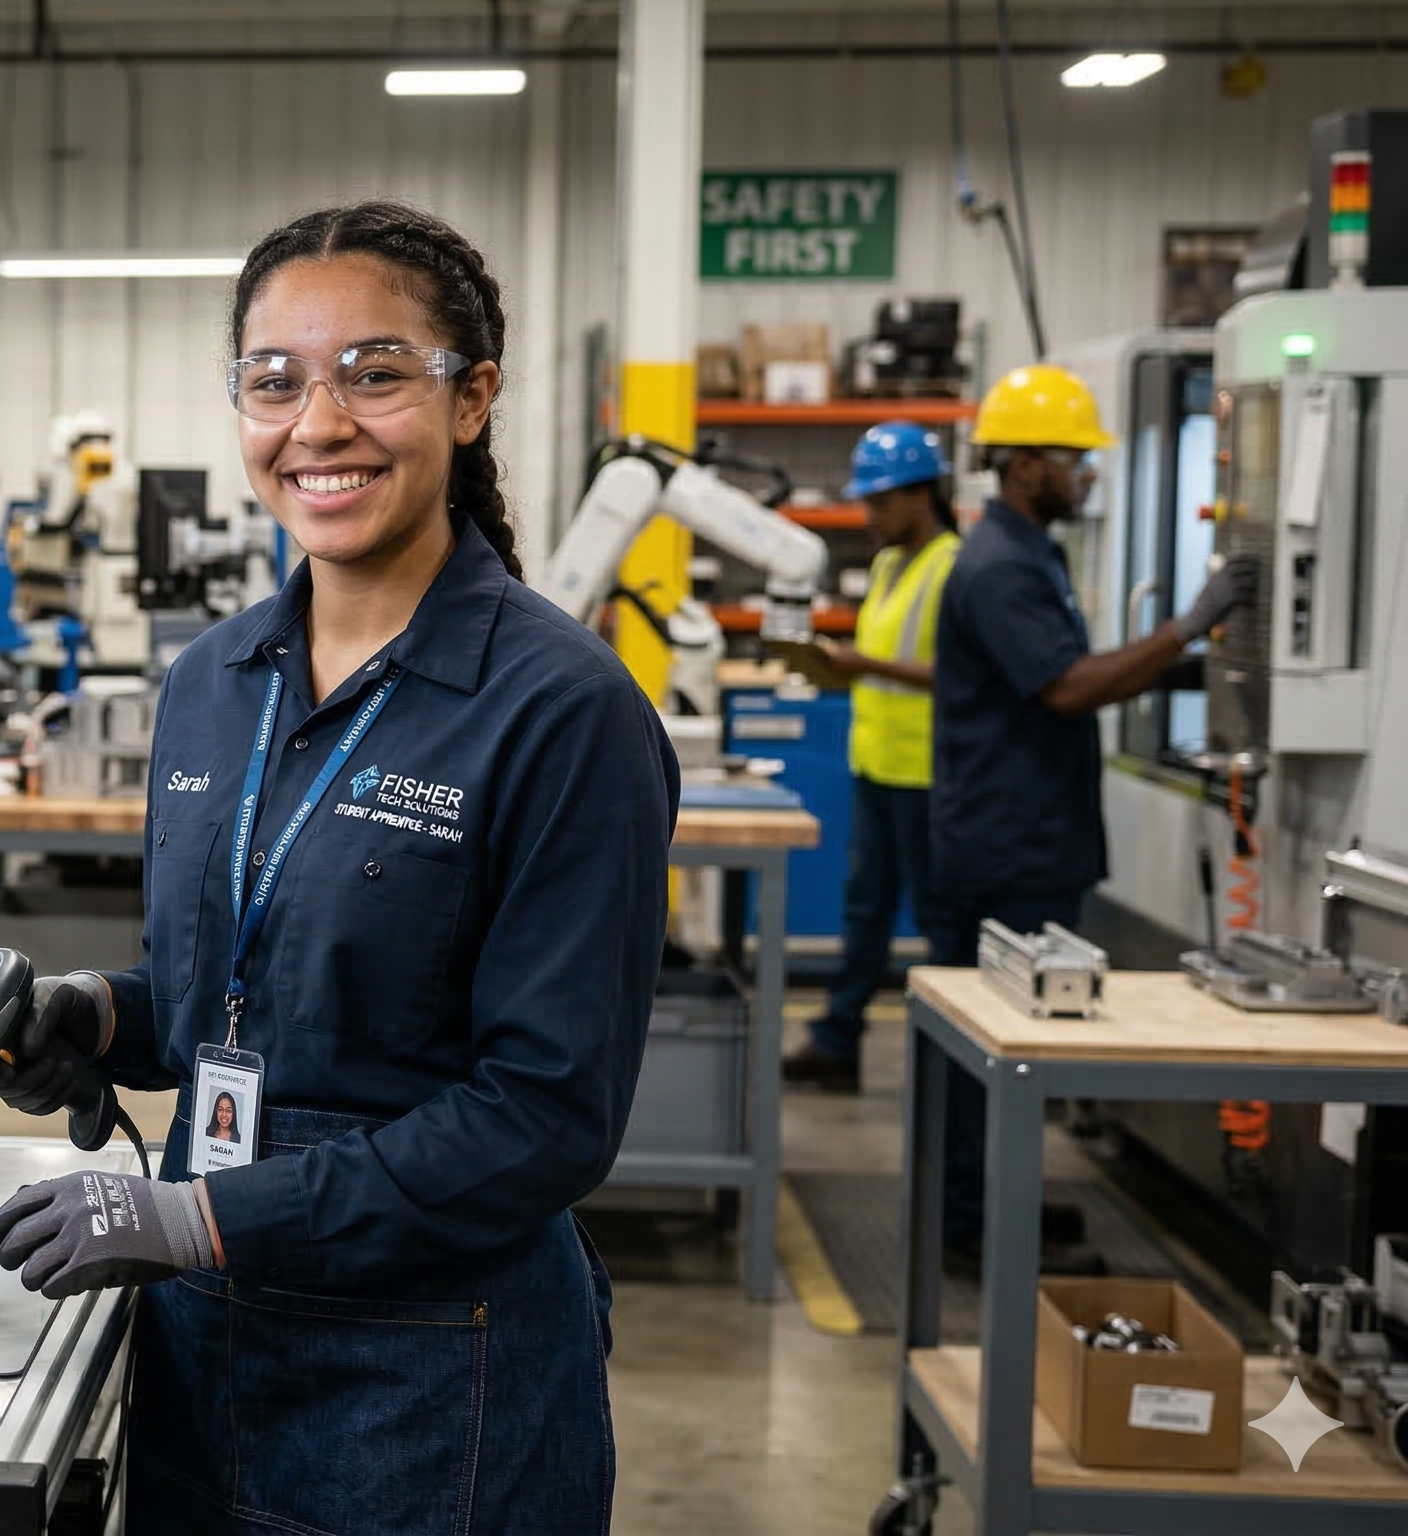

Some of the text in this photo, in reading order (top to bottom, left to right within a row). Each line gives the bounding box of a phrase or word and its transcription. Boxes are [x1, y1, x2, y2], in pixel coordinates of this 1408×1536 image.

[702, 179, 884, 225] SAFETY
[724, 228, 860, 273] FIRST
[168, 771, 210, 792] Sarah
[380, 774, 464, 809] FISHER
[376, 792, 402, 808] TECH
[428, 823, 463, 843] SARAH
